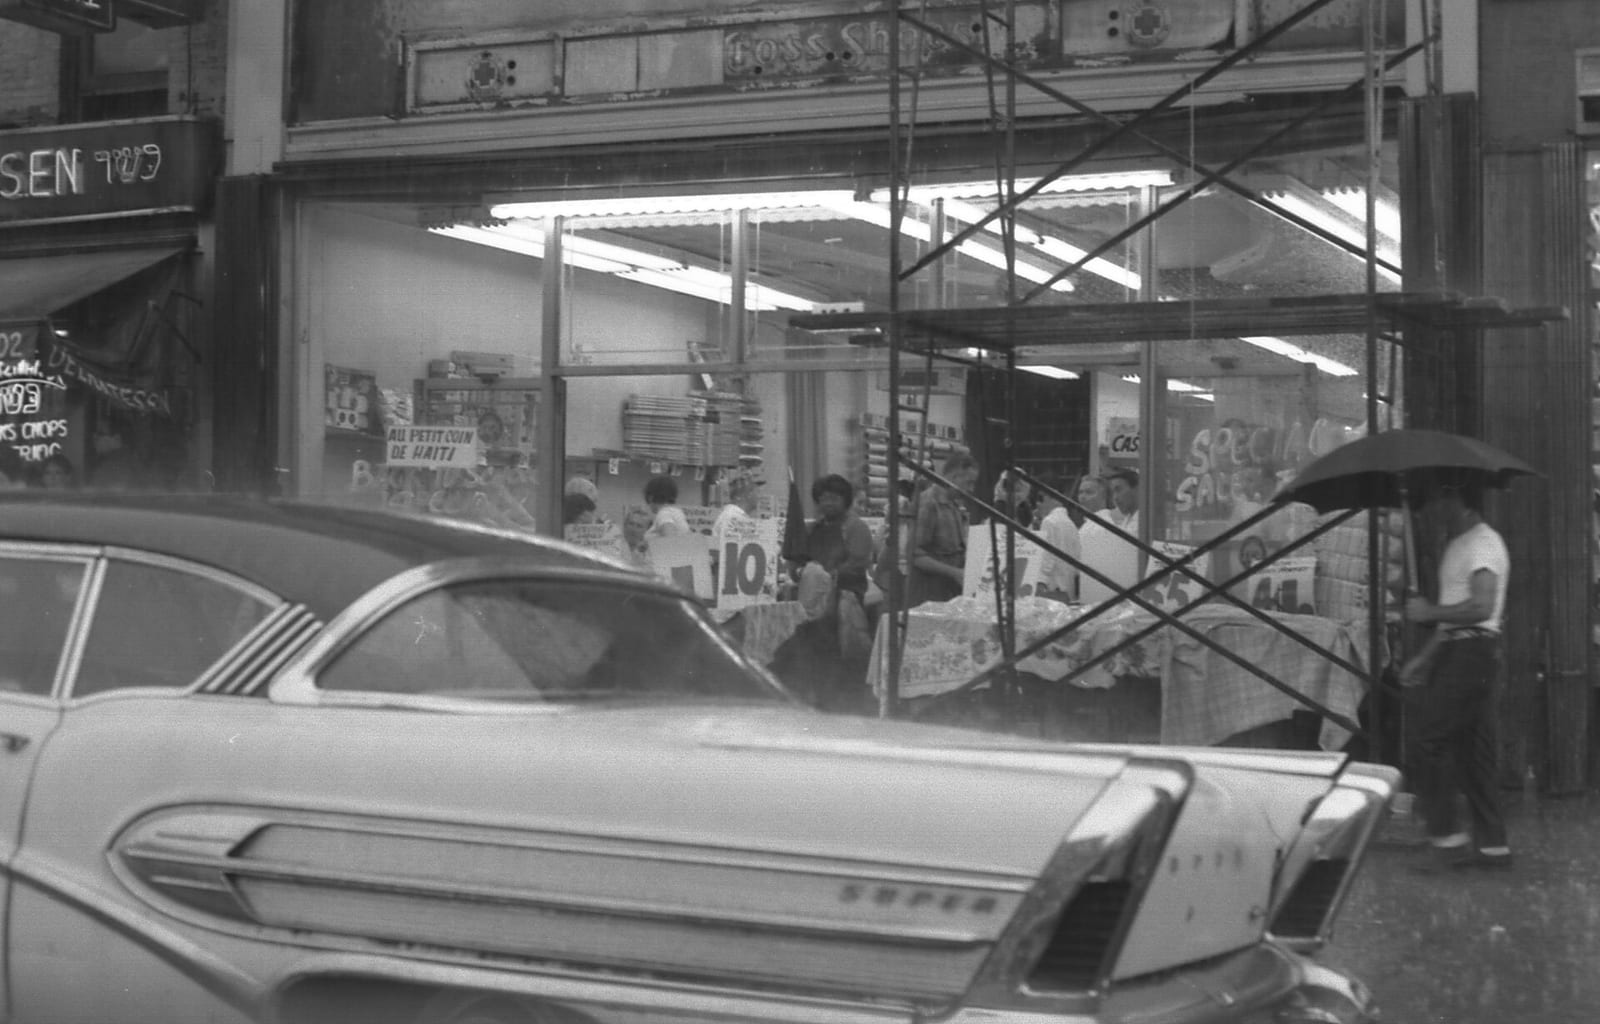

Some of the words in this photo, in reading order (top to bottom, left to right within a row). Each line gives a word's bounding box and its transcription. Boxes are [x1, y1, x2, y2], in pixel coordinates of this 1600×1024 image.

[389, 428, 407, 442] AU
[409, 428, 445, 443] PETIT
[446, 430, 473, 444] COIN
[1111, 435, 1140, 452] CAS
[391, 445, 407, 459] DE
[413, 445, 456, 461] HAITI
